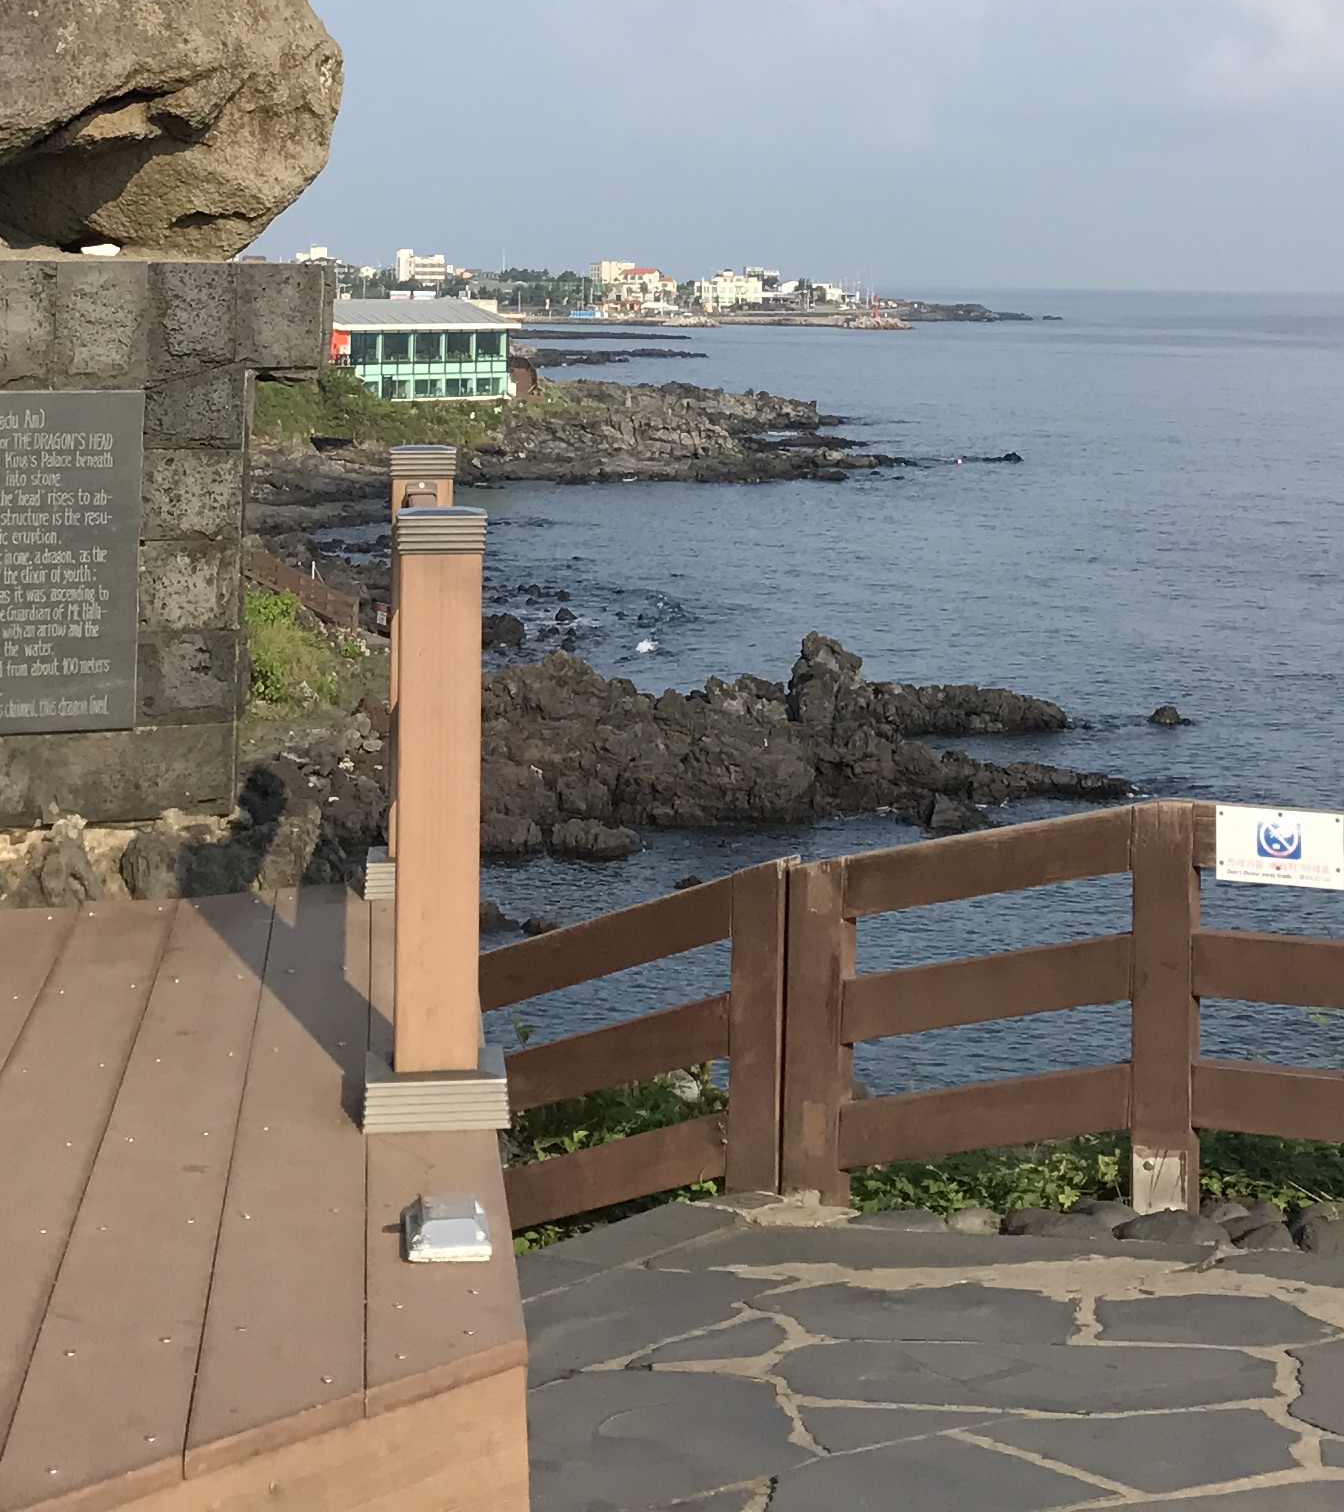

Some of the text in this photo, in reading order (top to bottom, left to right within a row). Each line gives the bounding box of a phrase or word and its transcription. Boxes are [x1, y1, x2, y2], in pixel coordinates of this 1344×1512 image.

[12, 432, 31, 451] THE
[89, 432, 113, 451] HEAD
[6, 451, 37, 469] King's
[41, 451, 72, 468] Palace
[75, 450, 114, 468] beneath
[6, 470, 27, 487] into
[78, 488, 90, 506] to
[0, 509, 50, 527] structure
[52, 509, 62, 526] is
[64, 508, 80, 526] the
[92, 546, 108, 563] the
[3, 567, 19, 585] the
[51, 565, 64, 583] of
[14, 586, 24, 604] it
[25, 588, 47, 603] was
[50, 584, 96, 603] ascending
[98, 584, 110, 601] to
[6, 603, 51, 623] Guardian
[52, 603, 64, 621] of
[67, 621, 83, 639] and
[84, 620, 100, 638] the
[5, 640, 19, 658] the
[5, 659, 28, 678] from
[30, 658, 60, 676] about
[62, 657, 79, 676] 100
[79, 657, 111, 675] meters
